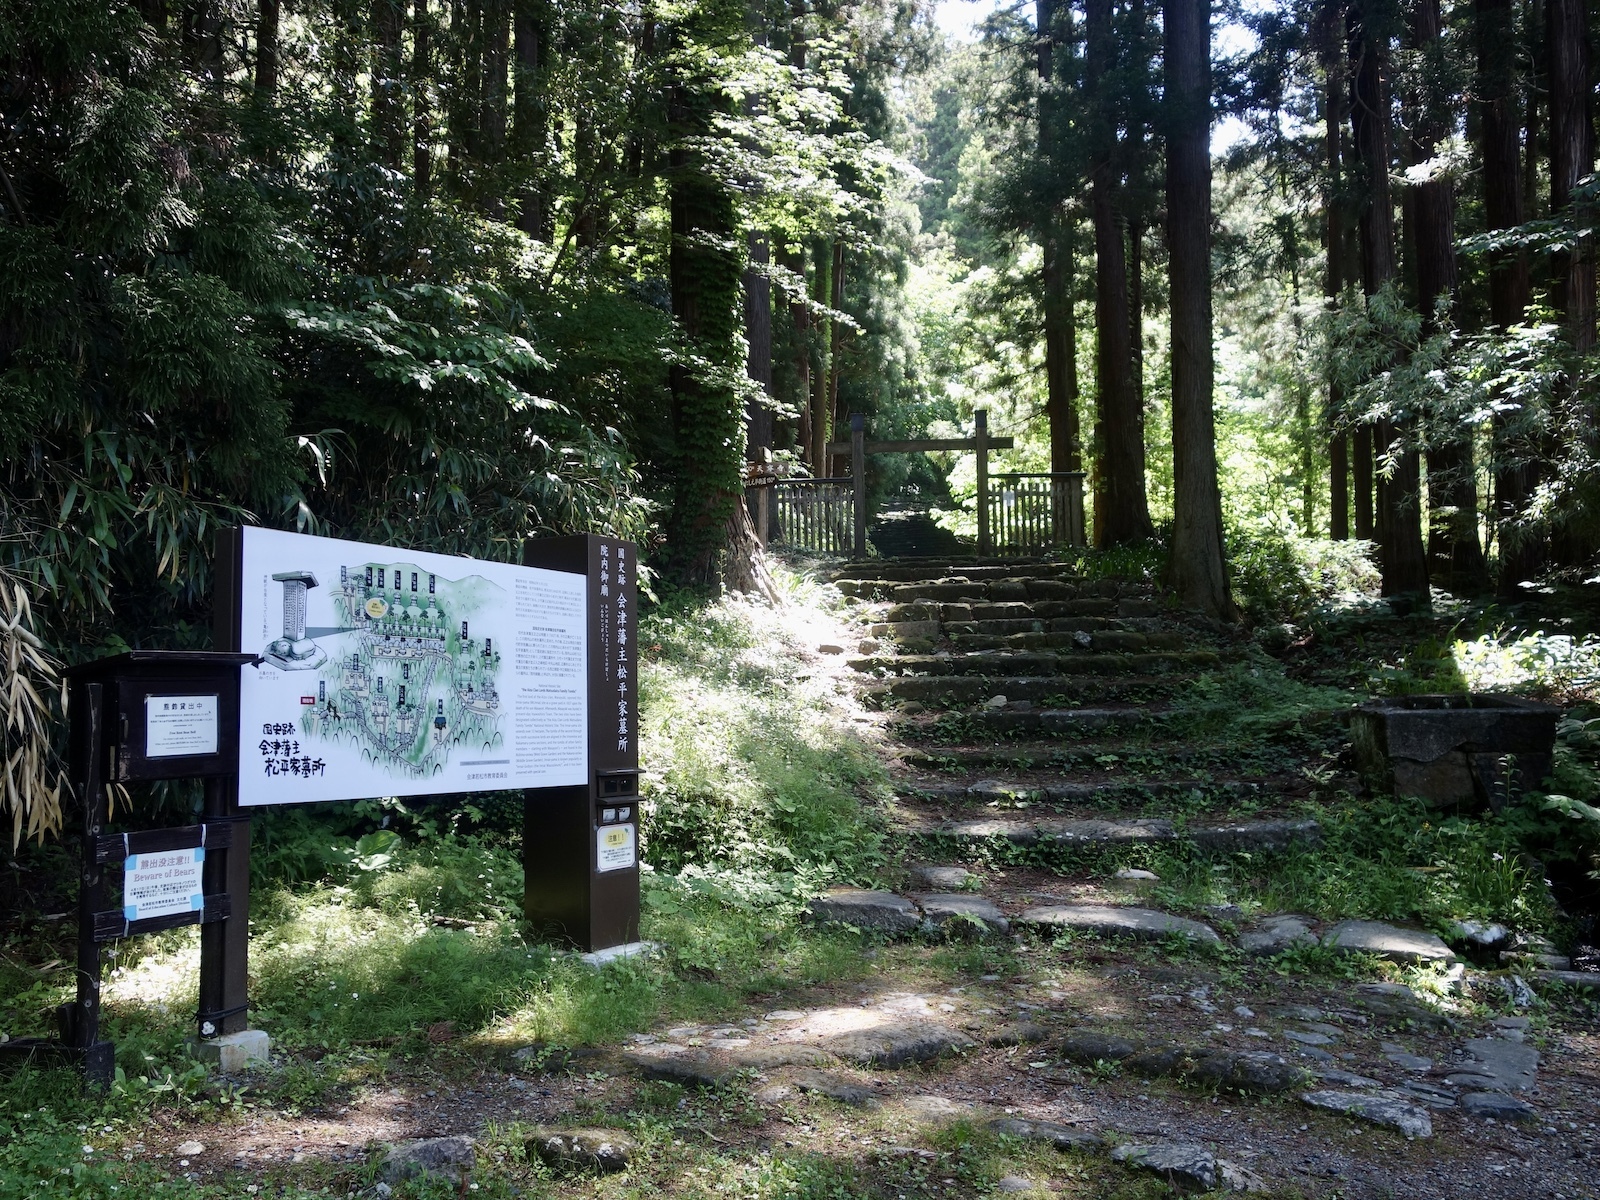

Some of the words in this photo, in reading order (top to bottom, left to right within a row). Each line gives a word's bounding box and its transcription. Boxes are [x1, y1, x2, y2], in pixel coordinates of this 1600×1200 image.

[616, 592, 628, 753] 会津藩主松平家墓所
[262, 722, 296, 736] 国史跡
[258, 739, 300, 757] 会津藩主
[264, 755, 326, 778] 松平家墓所
[134, 872, 162, 882] Beware
[165, 870, 172, 878] of
[174, 868, 195, 877] Bears
